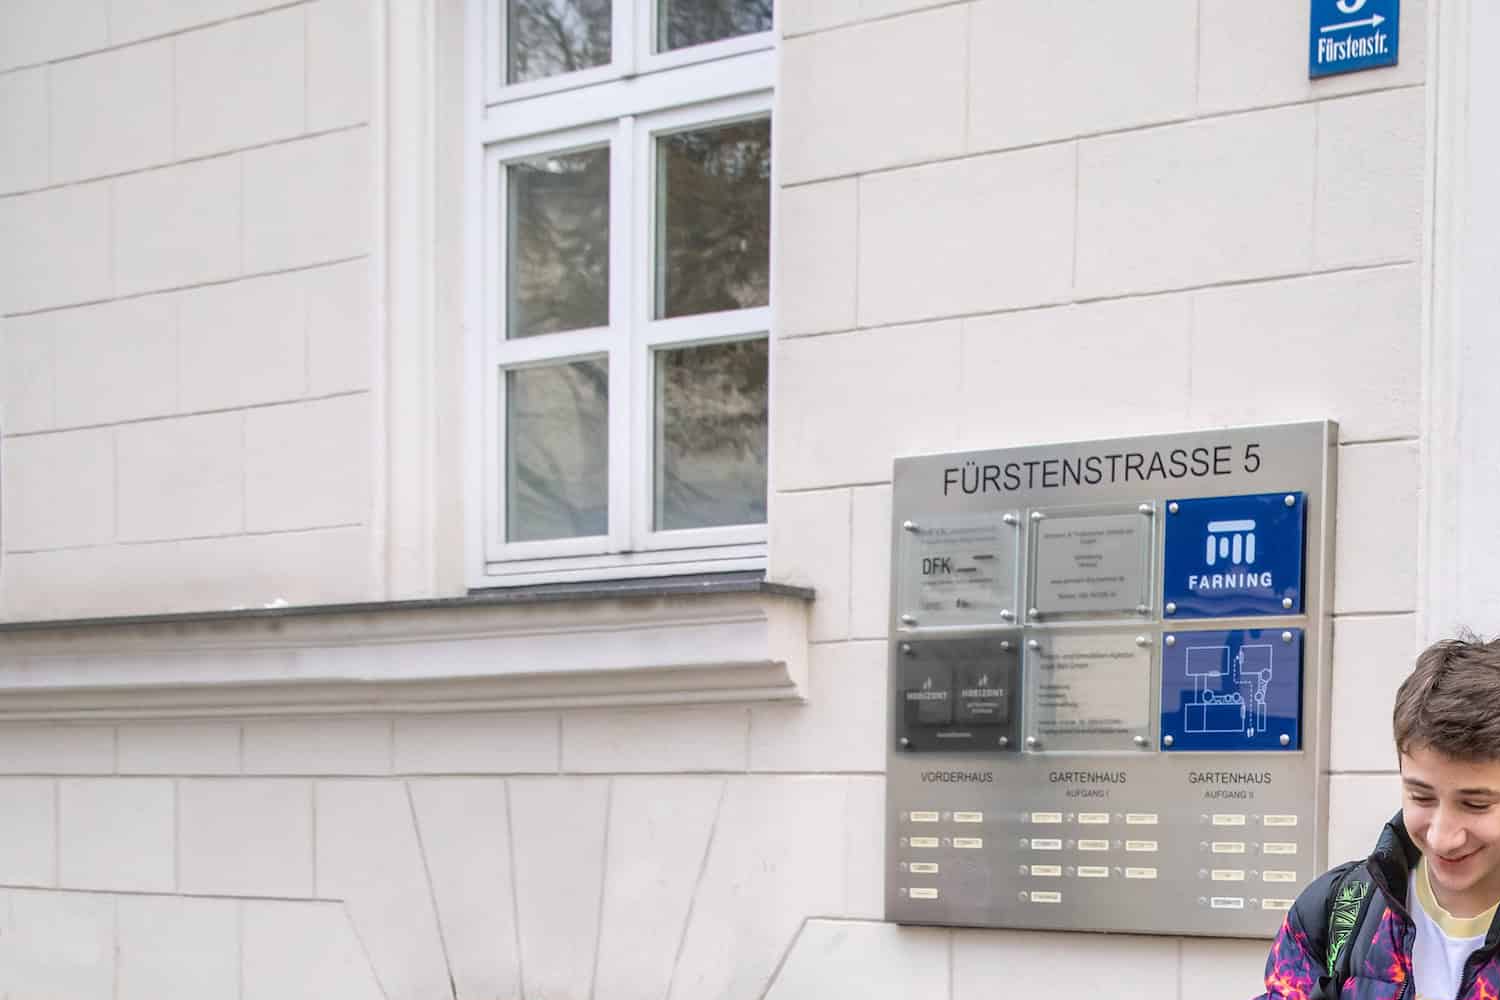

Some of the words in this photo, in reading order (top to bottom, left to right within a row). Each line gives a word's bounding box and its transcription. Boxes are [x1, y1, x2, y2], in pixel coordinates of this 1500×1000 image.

[1317, 28, 1389, 64] Fürstenstr.
[944, 446, 1232, 496] FÜRSTENSTRASSE
[1243, 444, 1261, 473] 5
[922, 556, 951, 576] DFK
[1188, 571, 1272, 591] FARNING
[920, 771, 993, 783] VORDERHAUS
[1048, 771, 1127, 784] GARTENHAUS
[1188, 771, 1272, 784] GARTENHAUS
[1204, 790, 1247, 799] AUFGANG
